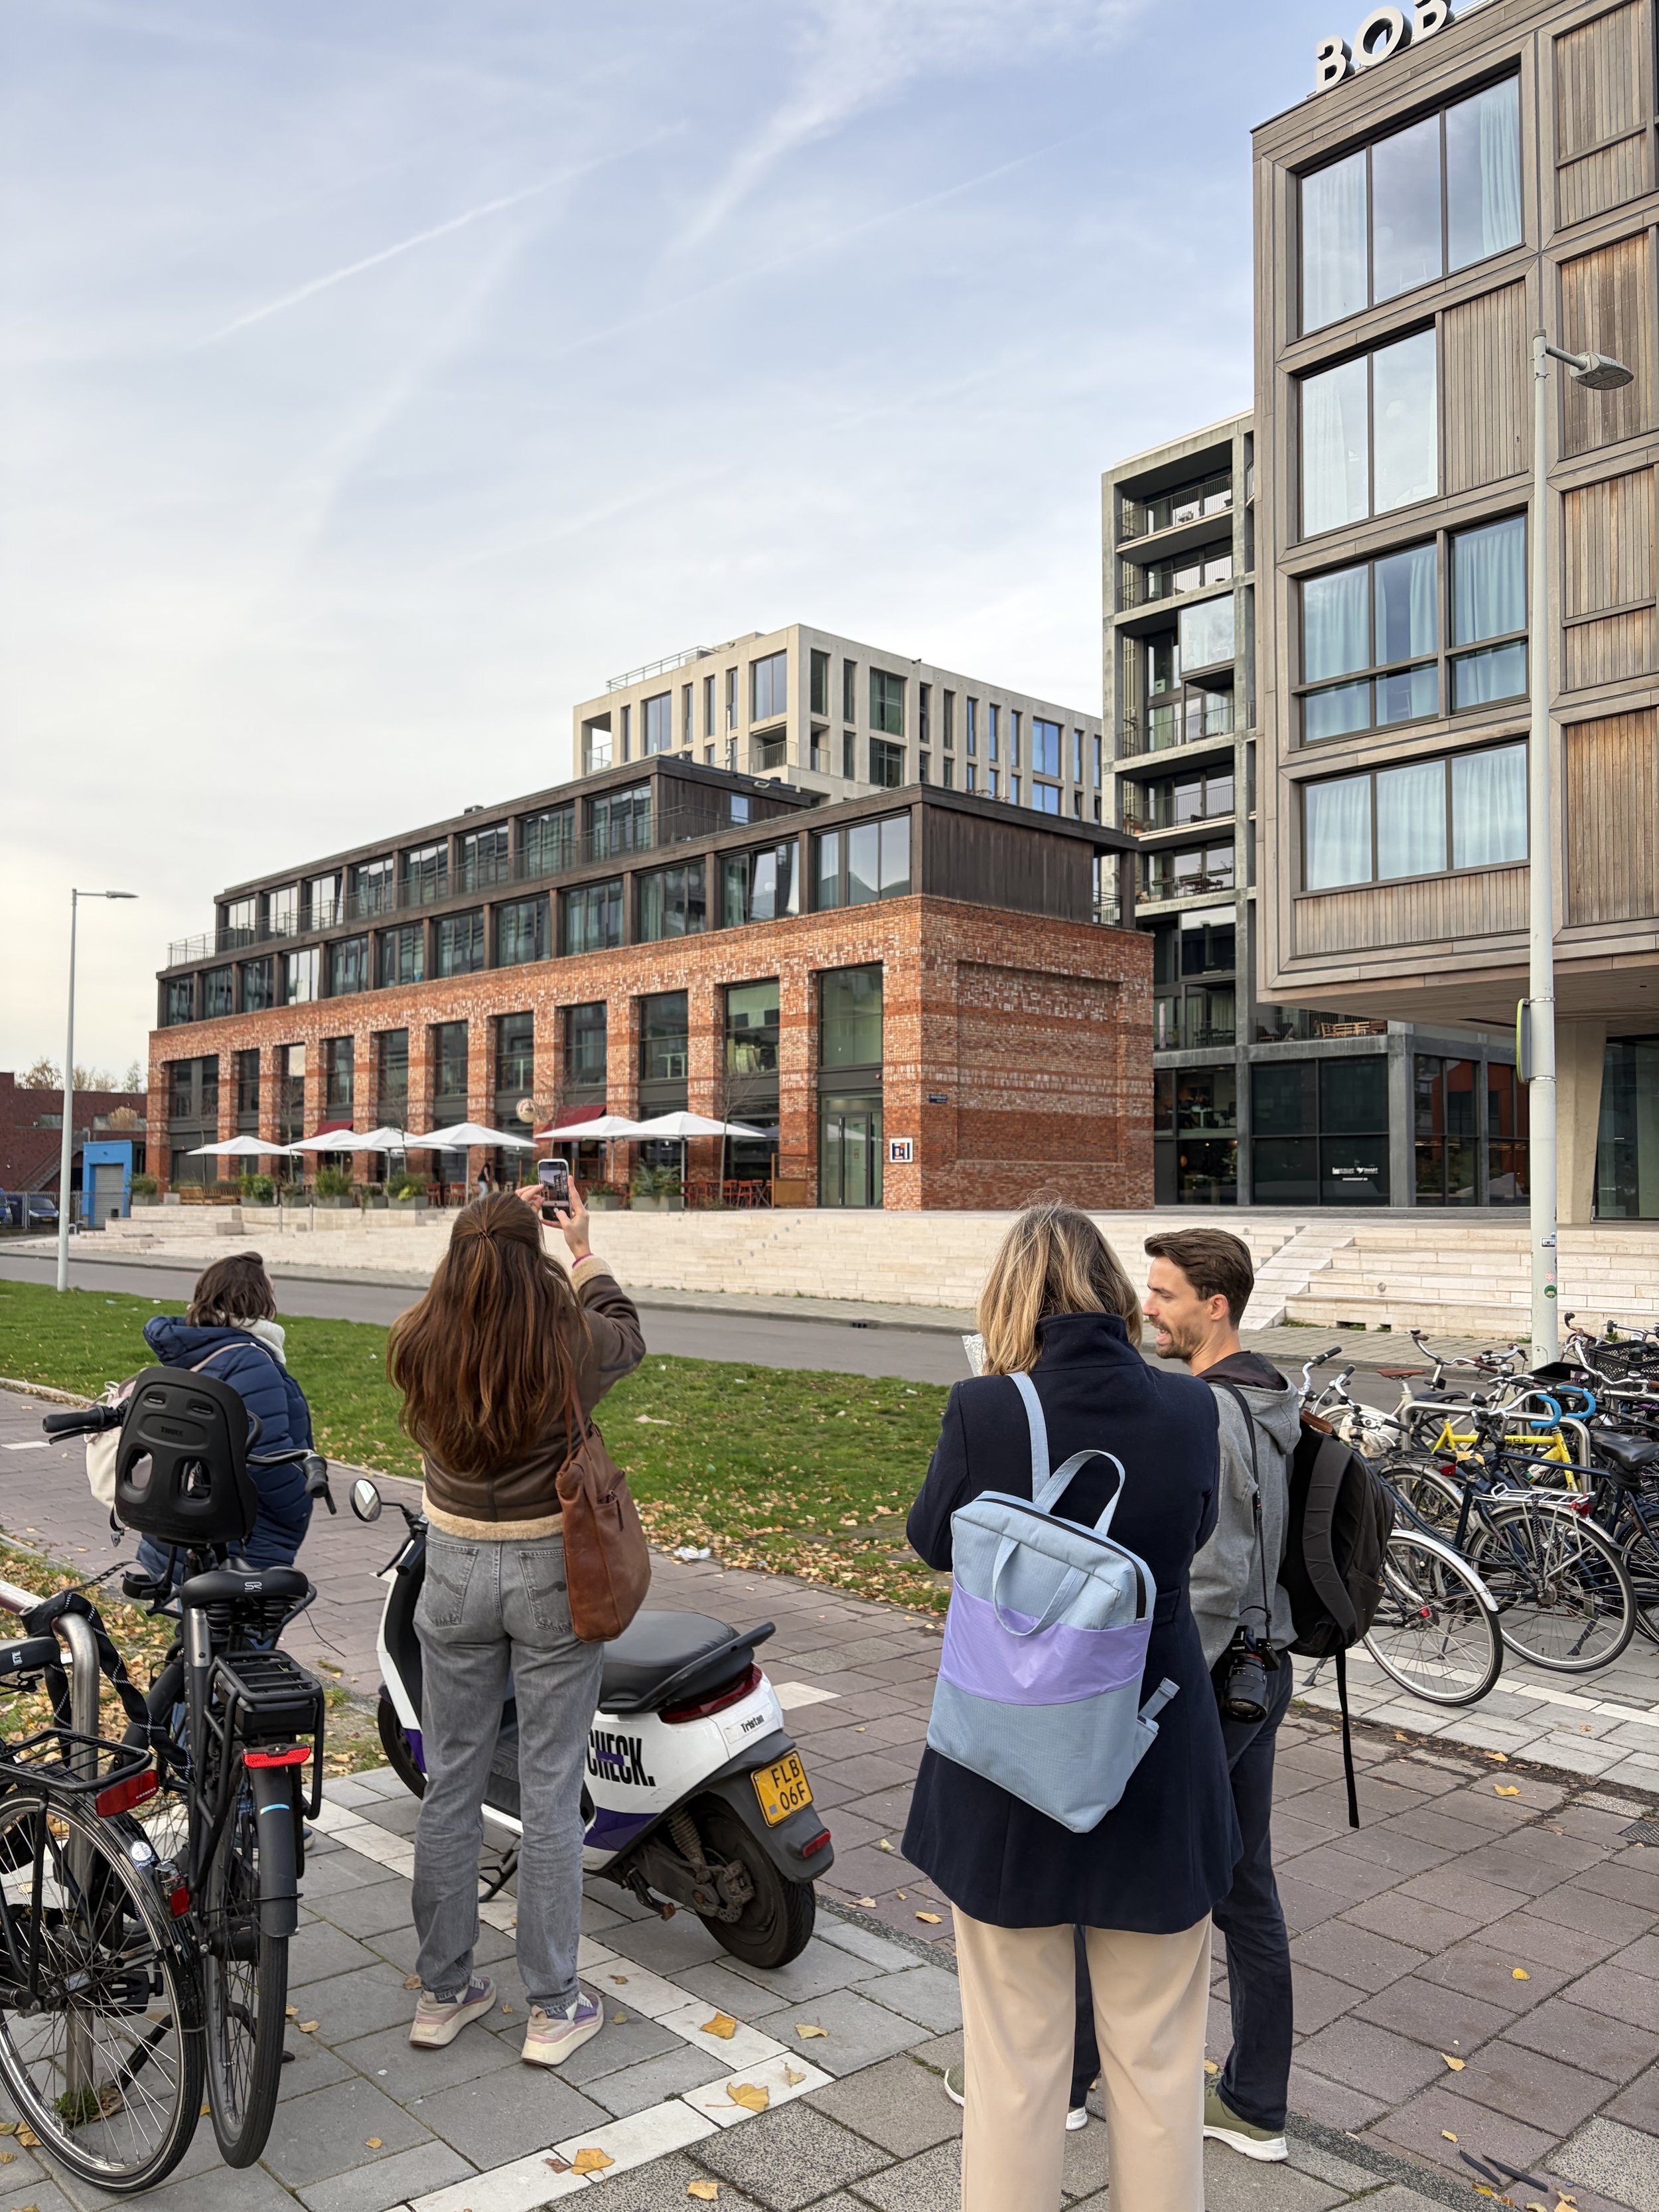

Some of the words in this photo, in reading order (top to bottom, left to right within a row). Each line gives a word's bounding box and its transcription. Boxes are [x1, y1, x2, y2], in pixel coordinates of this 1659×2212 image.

[1317, 0, 1453, 94] BOB
[741, 1714, 764, 1733] Tristan
[770, 1759, 800, 1789] FLB
[780, 1780, 806, 1810] 06F
